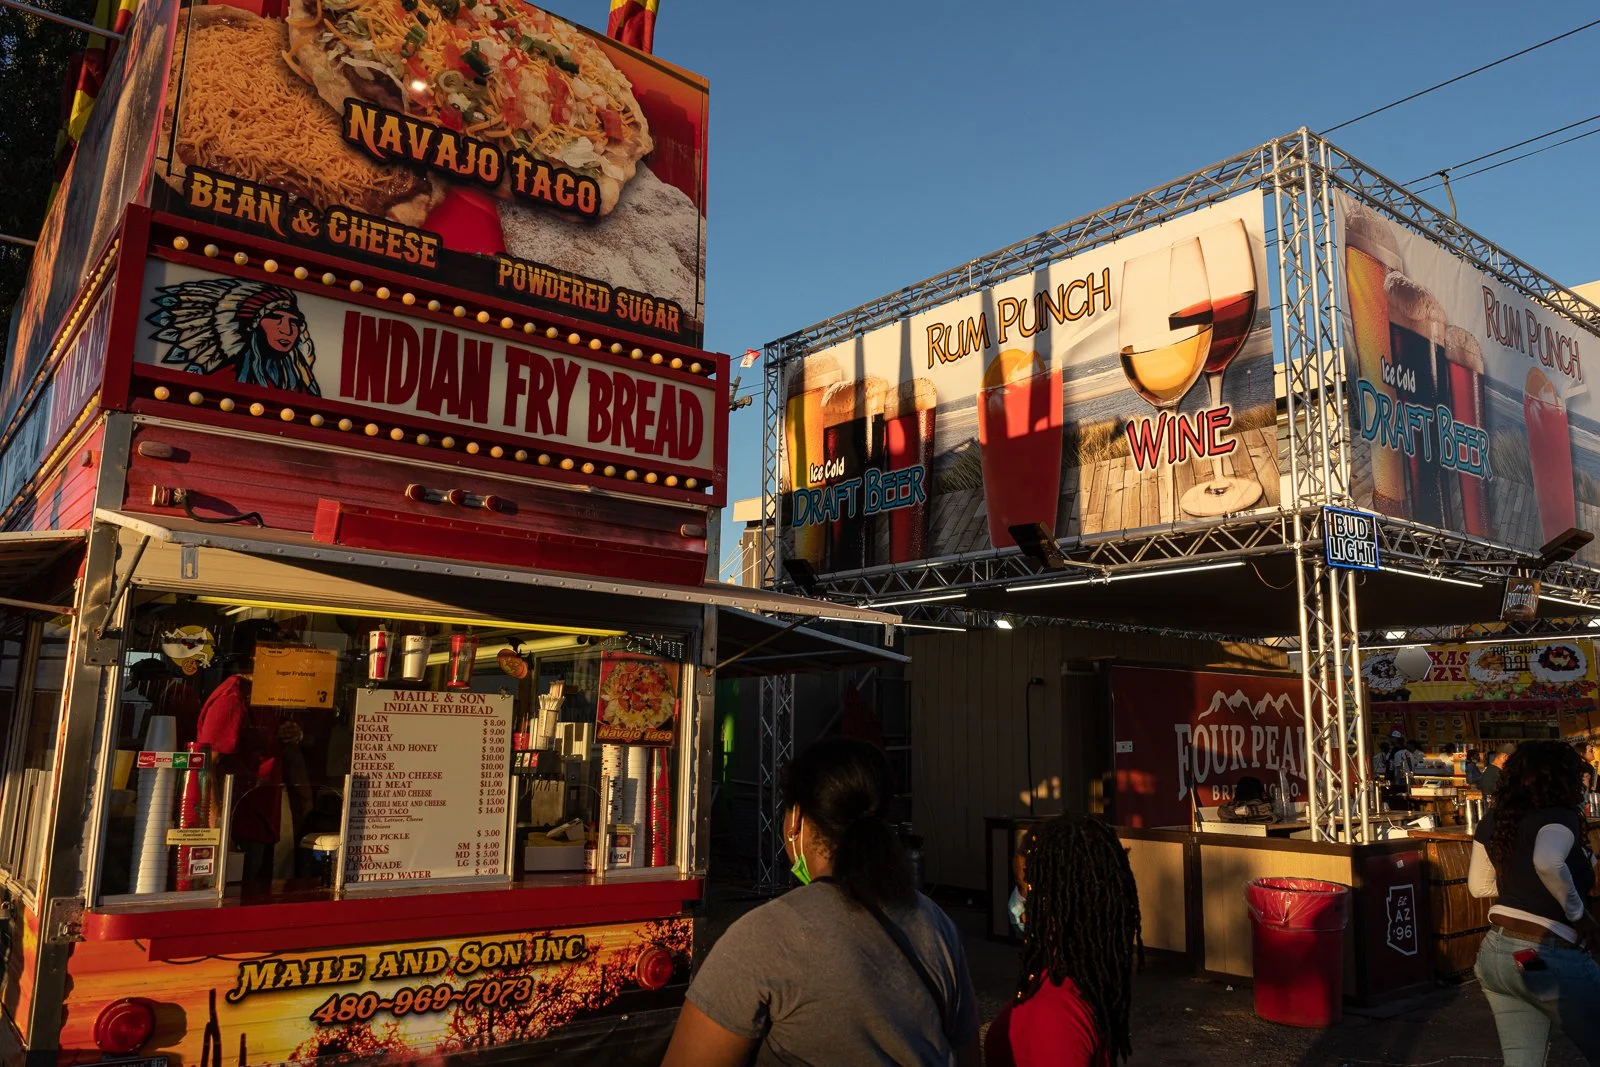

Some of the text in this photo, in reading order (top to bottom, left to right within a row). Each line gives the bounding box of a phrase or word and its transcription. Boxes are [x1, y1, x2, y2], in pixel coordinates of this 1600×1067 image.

[347, 103, 598, 213] NAVAJO TACO
[190, 171, 439, 269] BEAN & CHEESE
[498, 257, 681, 333] POWDERED SUGAR
[926, 267, 1111, 370] RUM PUNCH
[1482, 285, 1583, 382] RUM PUNCH
[1381, 356, 1416, 393] Ice Cold
[340, 311, 705, 461] INDIAN FRY BREAD
[1357, 378, 1493, 481] DRAFT BEER
[1126, 406, 1237, 471] WINE
[809, 456, 846, 484] Ice Cold
[792, 464, 926, 528] DRAFT BEER
[1334, 513, 1368, 540] BUD
[1329, 536, 1376, 564] LIGHT
[1427, 651, 1470, 666] XAS
[393, 691, 487, 705] MAILE & SON
[383, 702, 494, 715] INDIAN FRYBREAD
[357, 714, 388, 723] PLAIN
[490, 719, 506, 727] 8.00
[355, 724, 389, 733] SUGAR
[489, 728, 505, 736] 9.00
[598, 727, 672, 742] Navajo Taco
[355, 733, 394, 742] HONEY
[489, 737, 505, 745] 9.00
[354, 743, 384, 752] SUGAR
[387, 743, 406, 752] AND
[408, 744, 438, 752] HONEY
[489, 746, 505, 754] 9.00
[353, 752, 505, 762] BEANS $10.00
[1174, 724, 1247, 801] FOUR
[353, 762, 504, 771] CHEESE $10.00
[353, 771, 504, 780] BEANS AND CHEESE $11.00
[351, 780, 503, 789] CHILI MEAT $11.00
[351, 790, 371, 798] CHILI
[372, 790, 391, 798] MEAT
[393, 790, 406, 798] AND
[408, 790, 432, 798] CHEESE
[372, 800, 391, 808] CHILI
[357, 808, 386, 817] NAVAJO
[348, 833, 378, 842] JUMBO
[380, 832, 410, 840] PICKLE
[484, 829, 500, 837] 3.00
[347, 845, 390, 854] DRINKS
[457, 842, 470, 850] SM
[483, 842, 500, 850] 4.00
[346, 855, 373, 863] SODA
[455, 851, 470, 859] MD
[482, 850, 499, 858] 5.00
[346, 861, 402, 871] LEMONADE
[457, 859, 470, 867] LG
[345, 872, 395, 882] BOTTLED
[397, 871, 431, 880] WATER
[1395, 908, 1411, 922] AZ
[228, 935, 589, 1002] MAILE AND SON INC.
